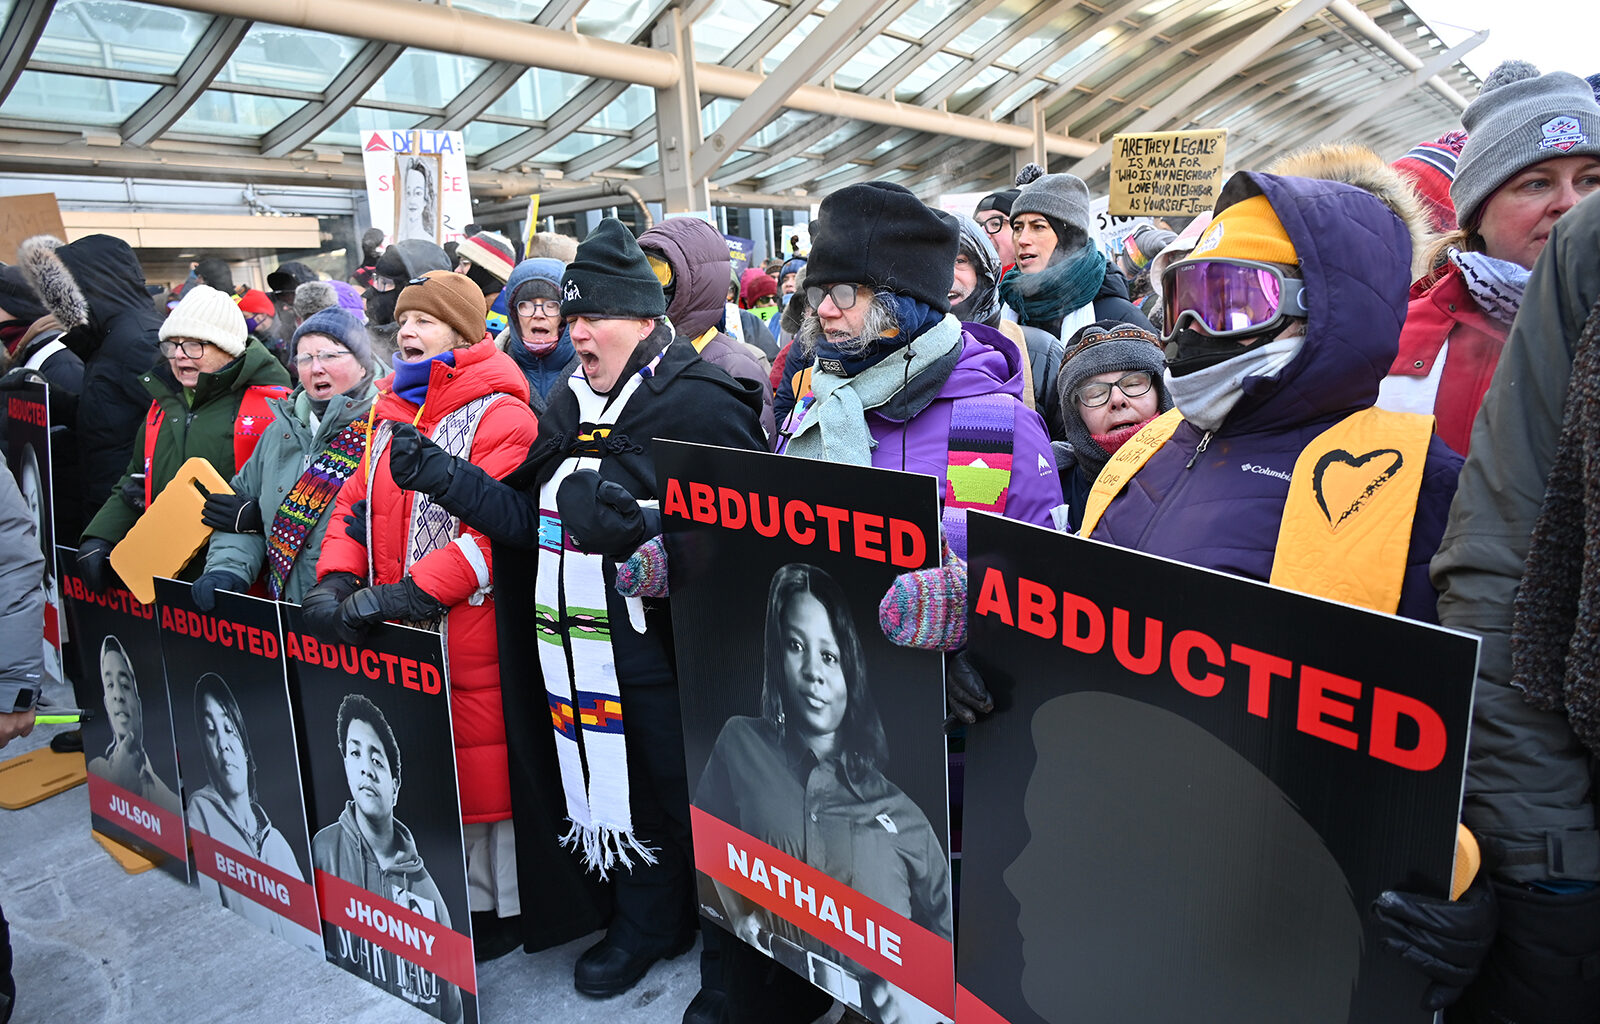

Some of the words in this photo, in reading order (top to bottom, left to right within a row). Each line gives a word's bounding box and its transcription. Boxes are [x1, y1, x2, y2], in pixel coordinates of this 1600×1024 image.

[1127, 158, 1144, 169] IS
[1147, 158, 1176, 168] MAGA
[1179, 157, 1201, 168] FOR
[1128, 183, 1151, 194] LOVE
[1173, 184, 1213, 197] NEIGHBOR
[1140, 170, 1152, 181] IS
[1153, 170, 1168, 181] MY
[1129, 198, 1143, 210] AS
[8, 396, 47, 428] ABDUCTED
[664, 477, 927, 569] ABDUCTED
[161, 605, 279, 659] ABDUCTED
[287, 631, 442, 696] ABDUCTED
[975, 566, 1448, 772] ABDUCTED
[108, 794, 162, 836] JULSON
[214, 851, 291, 907] BERTING
[727, 842, 903, 967] NATHALIE
[345, 897, 436, 957] JHONNY
